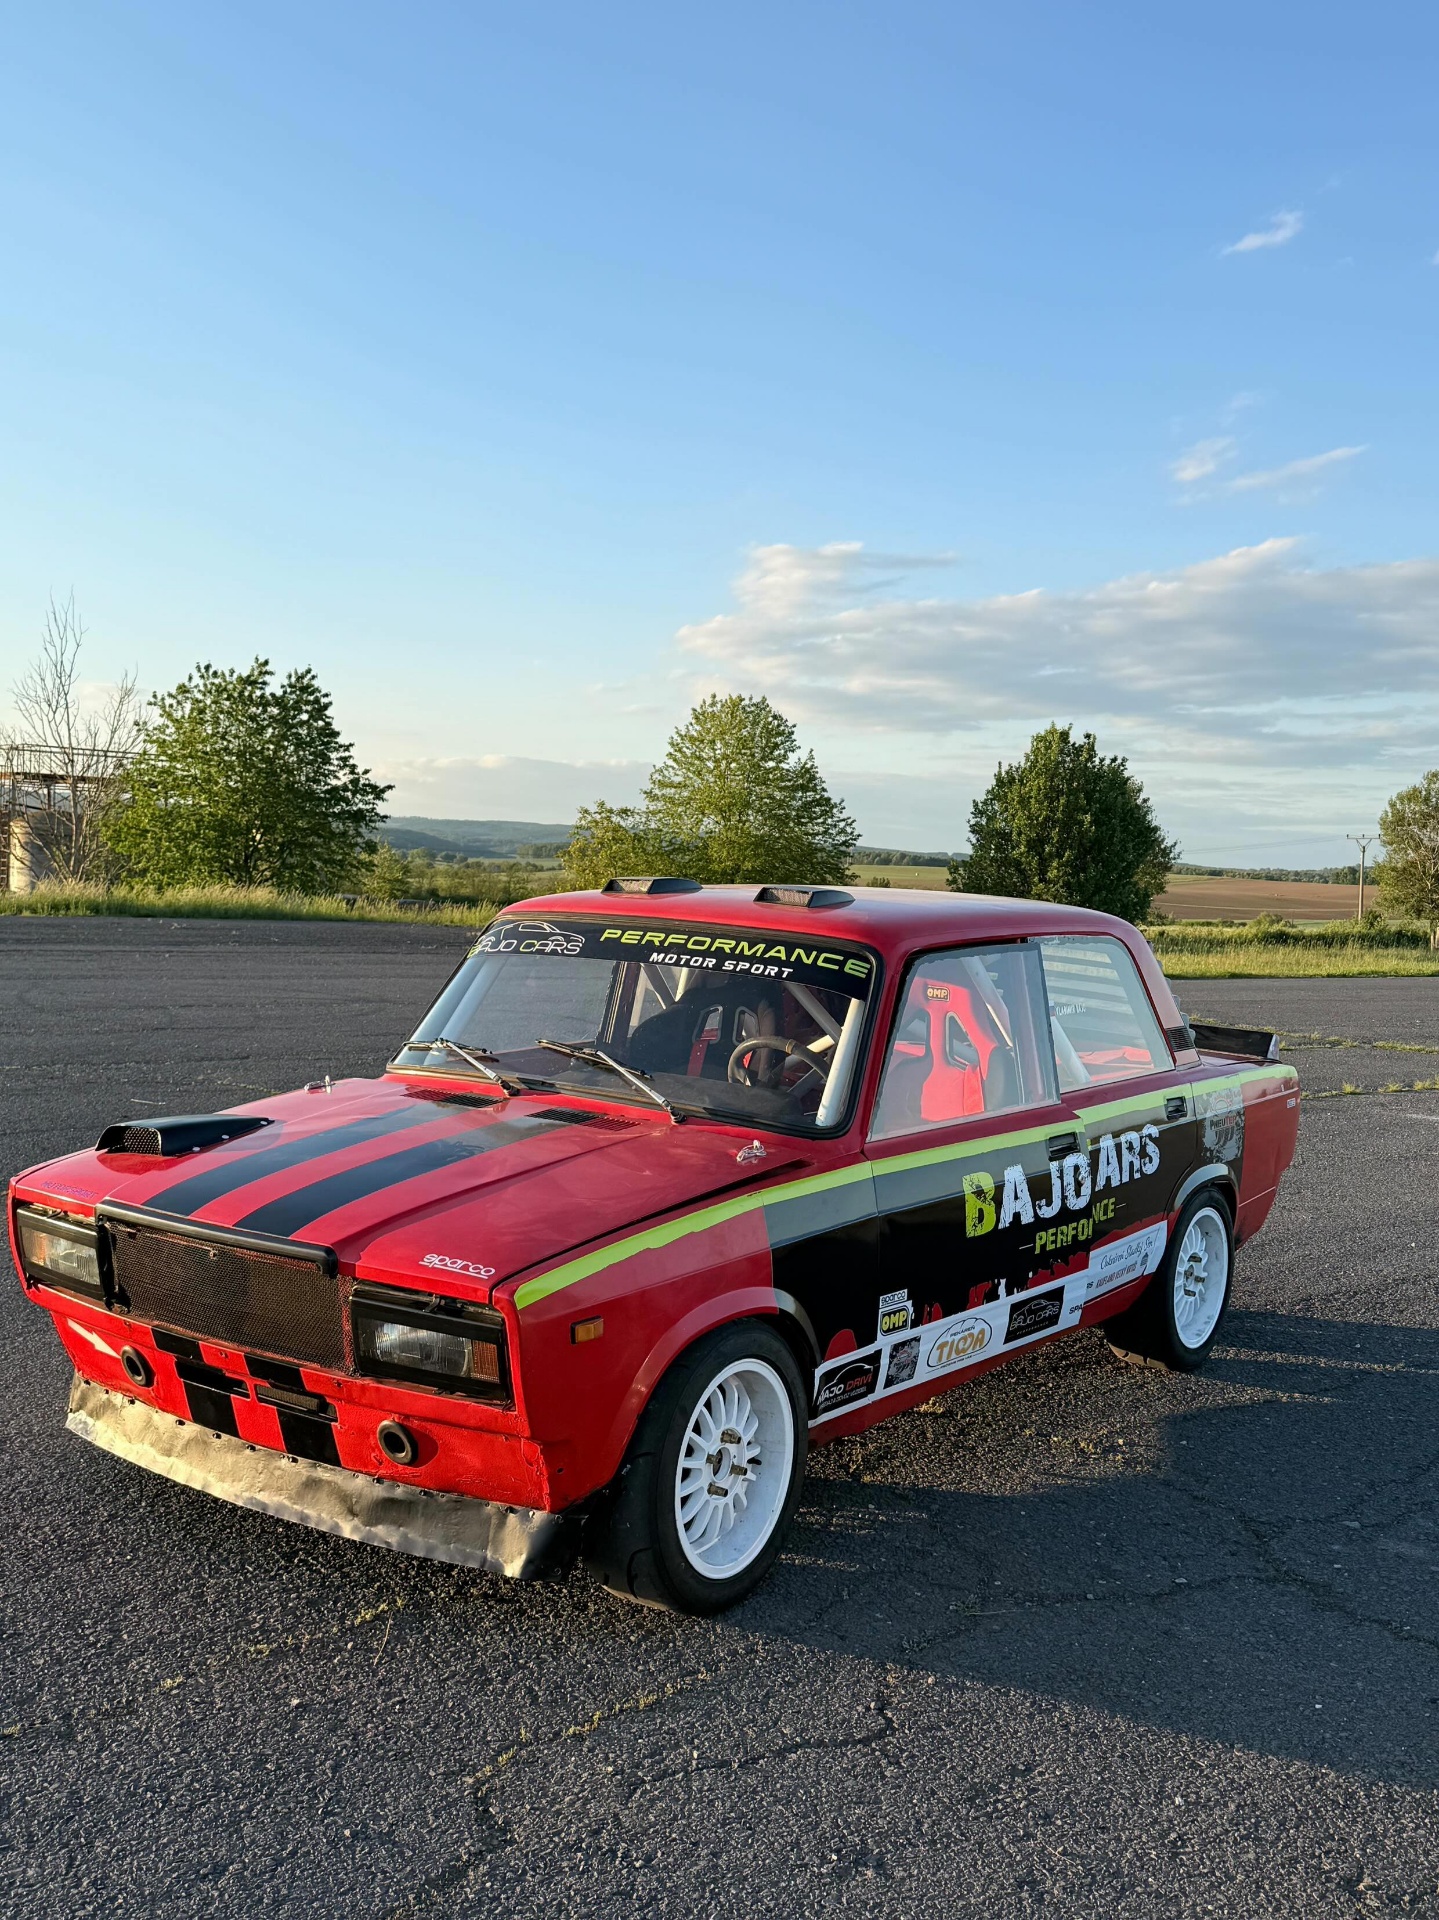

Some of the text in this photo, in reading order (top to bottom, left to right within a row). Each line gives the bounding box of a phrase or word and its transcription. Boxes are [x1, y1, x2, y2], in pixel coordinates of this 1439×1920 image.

[520, 940, 583, 955] CARS
[600, 929, 871, 979] PERFORMANCE
[649, 952, 794, 979] MOTOR SPORT
[927, 988, 948, 999] OMP
[962, 1153, 1092, 1239] BAJO
[422, 1253, 496, 1277] sparco
[882, 1310, 907, 1331] OMP
